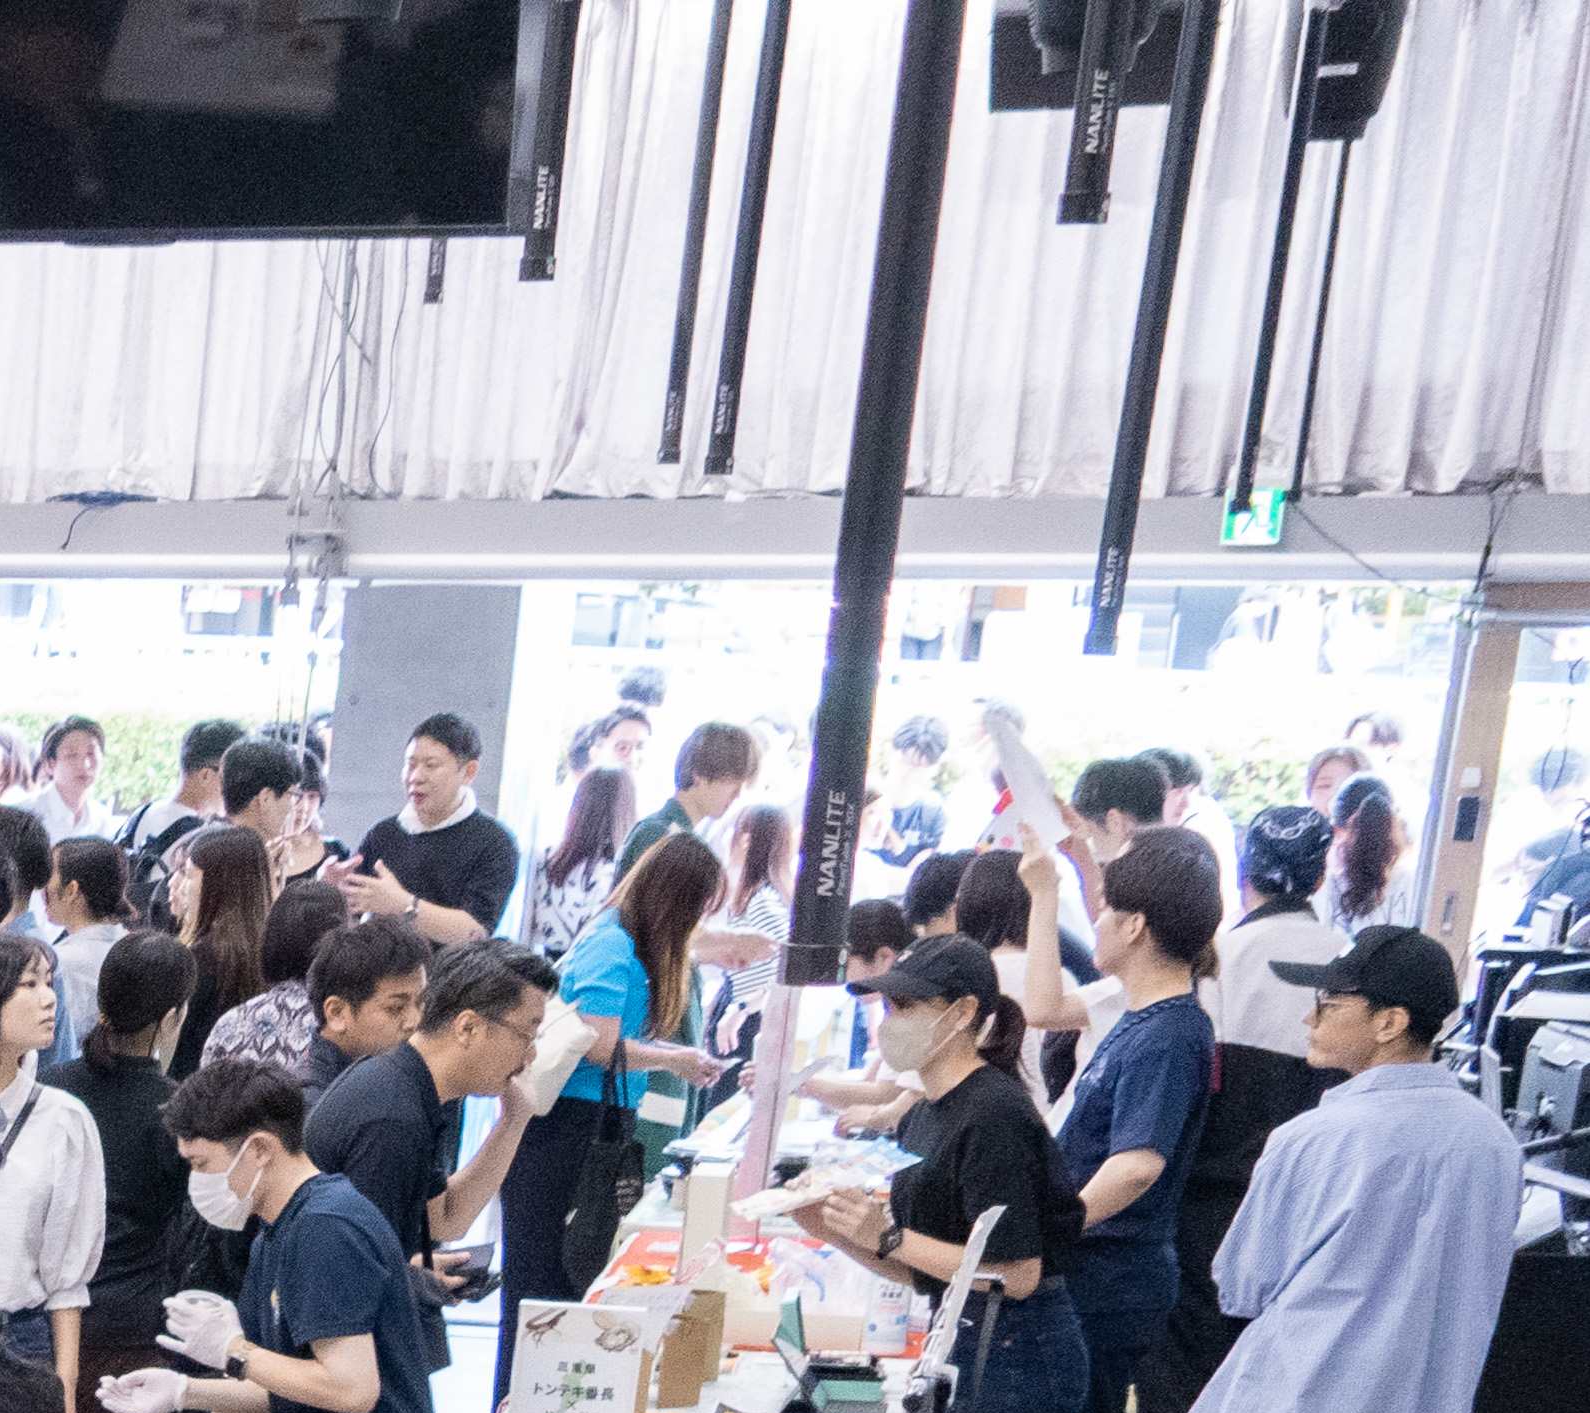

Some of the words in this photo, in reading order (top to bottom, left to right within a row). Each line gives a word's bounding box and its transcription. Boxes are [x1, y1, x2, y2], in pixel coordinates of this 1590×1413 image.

[1084, 69, 1110, 154] NANLITE
[533, 165, 550, 230] NANLITE
[816, 790, 846, 896] NANLITE
